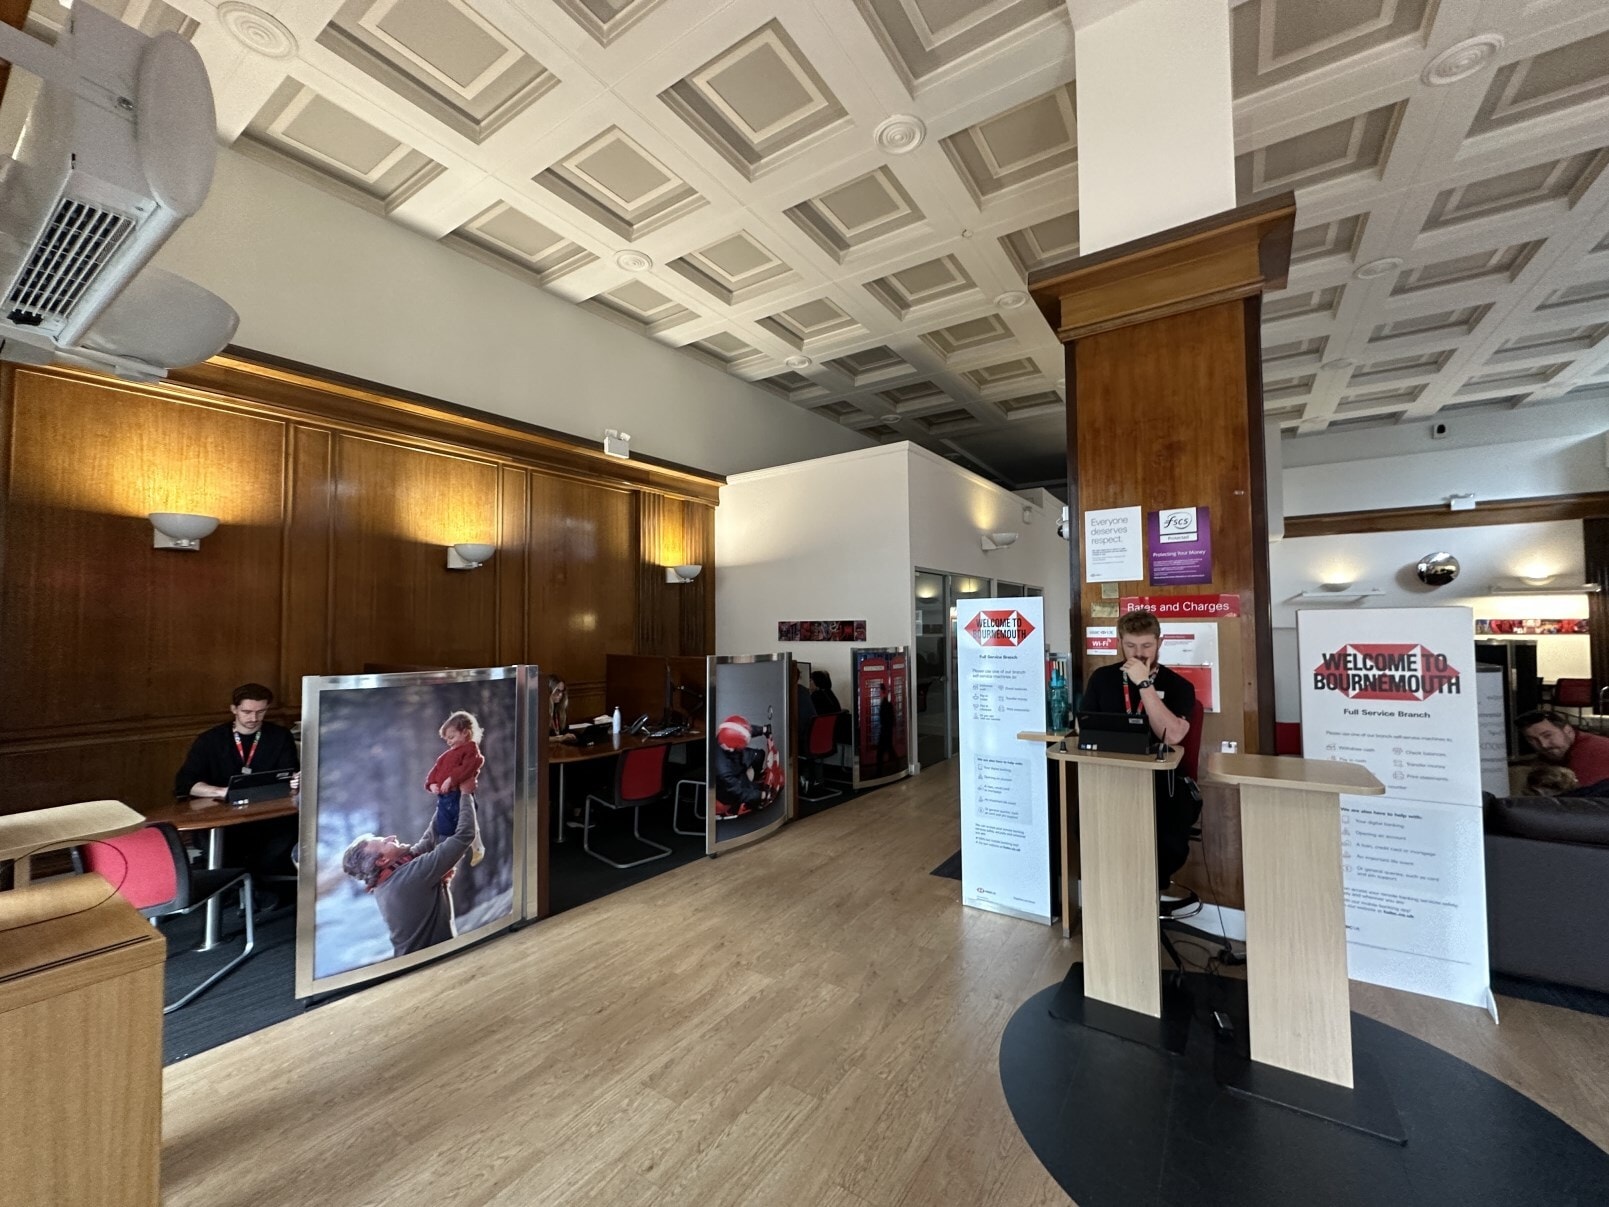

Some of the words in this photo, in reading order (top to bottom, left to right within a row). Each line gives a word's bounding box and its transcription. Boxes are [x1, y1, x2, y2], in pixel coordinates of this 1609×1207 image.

[1091, 517, 1128, 526] Everyone
[1091, 527, 1128, 535] deserves
[1091, 536, 1123, 545] respect.
[1160, 602, 1179, 611] and
[1183, 601, 1230, 612] Charges
[976, 618, 1011, 628] WELCOME
[1012, 617, 1022, 628] TO
[972, 629, 1027, 639] BOURNEMOUTH
[1322, 653, 1418, 672] WELCOME
[1421, 653, 1448, 672] TO
[1314, 673, 1461, 694] BOURNEMOUTH
[1361, 709, 1395, 717] Service
[1398, 710, 1431, 718] Branch
